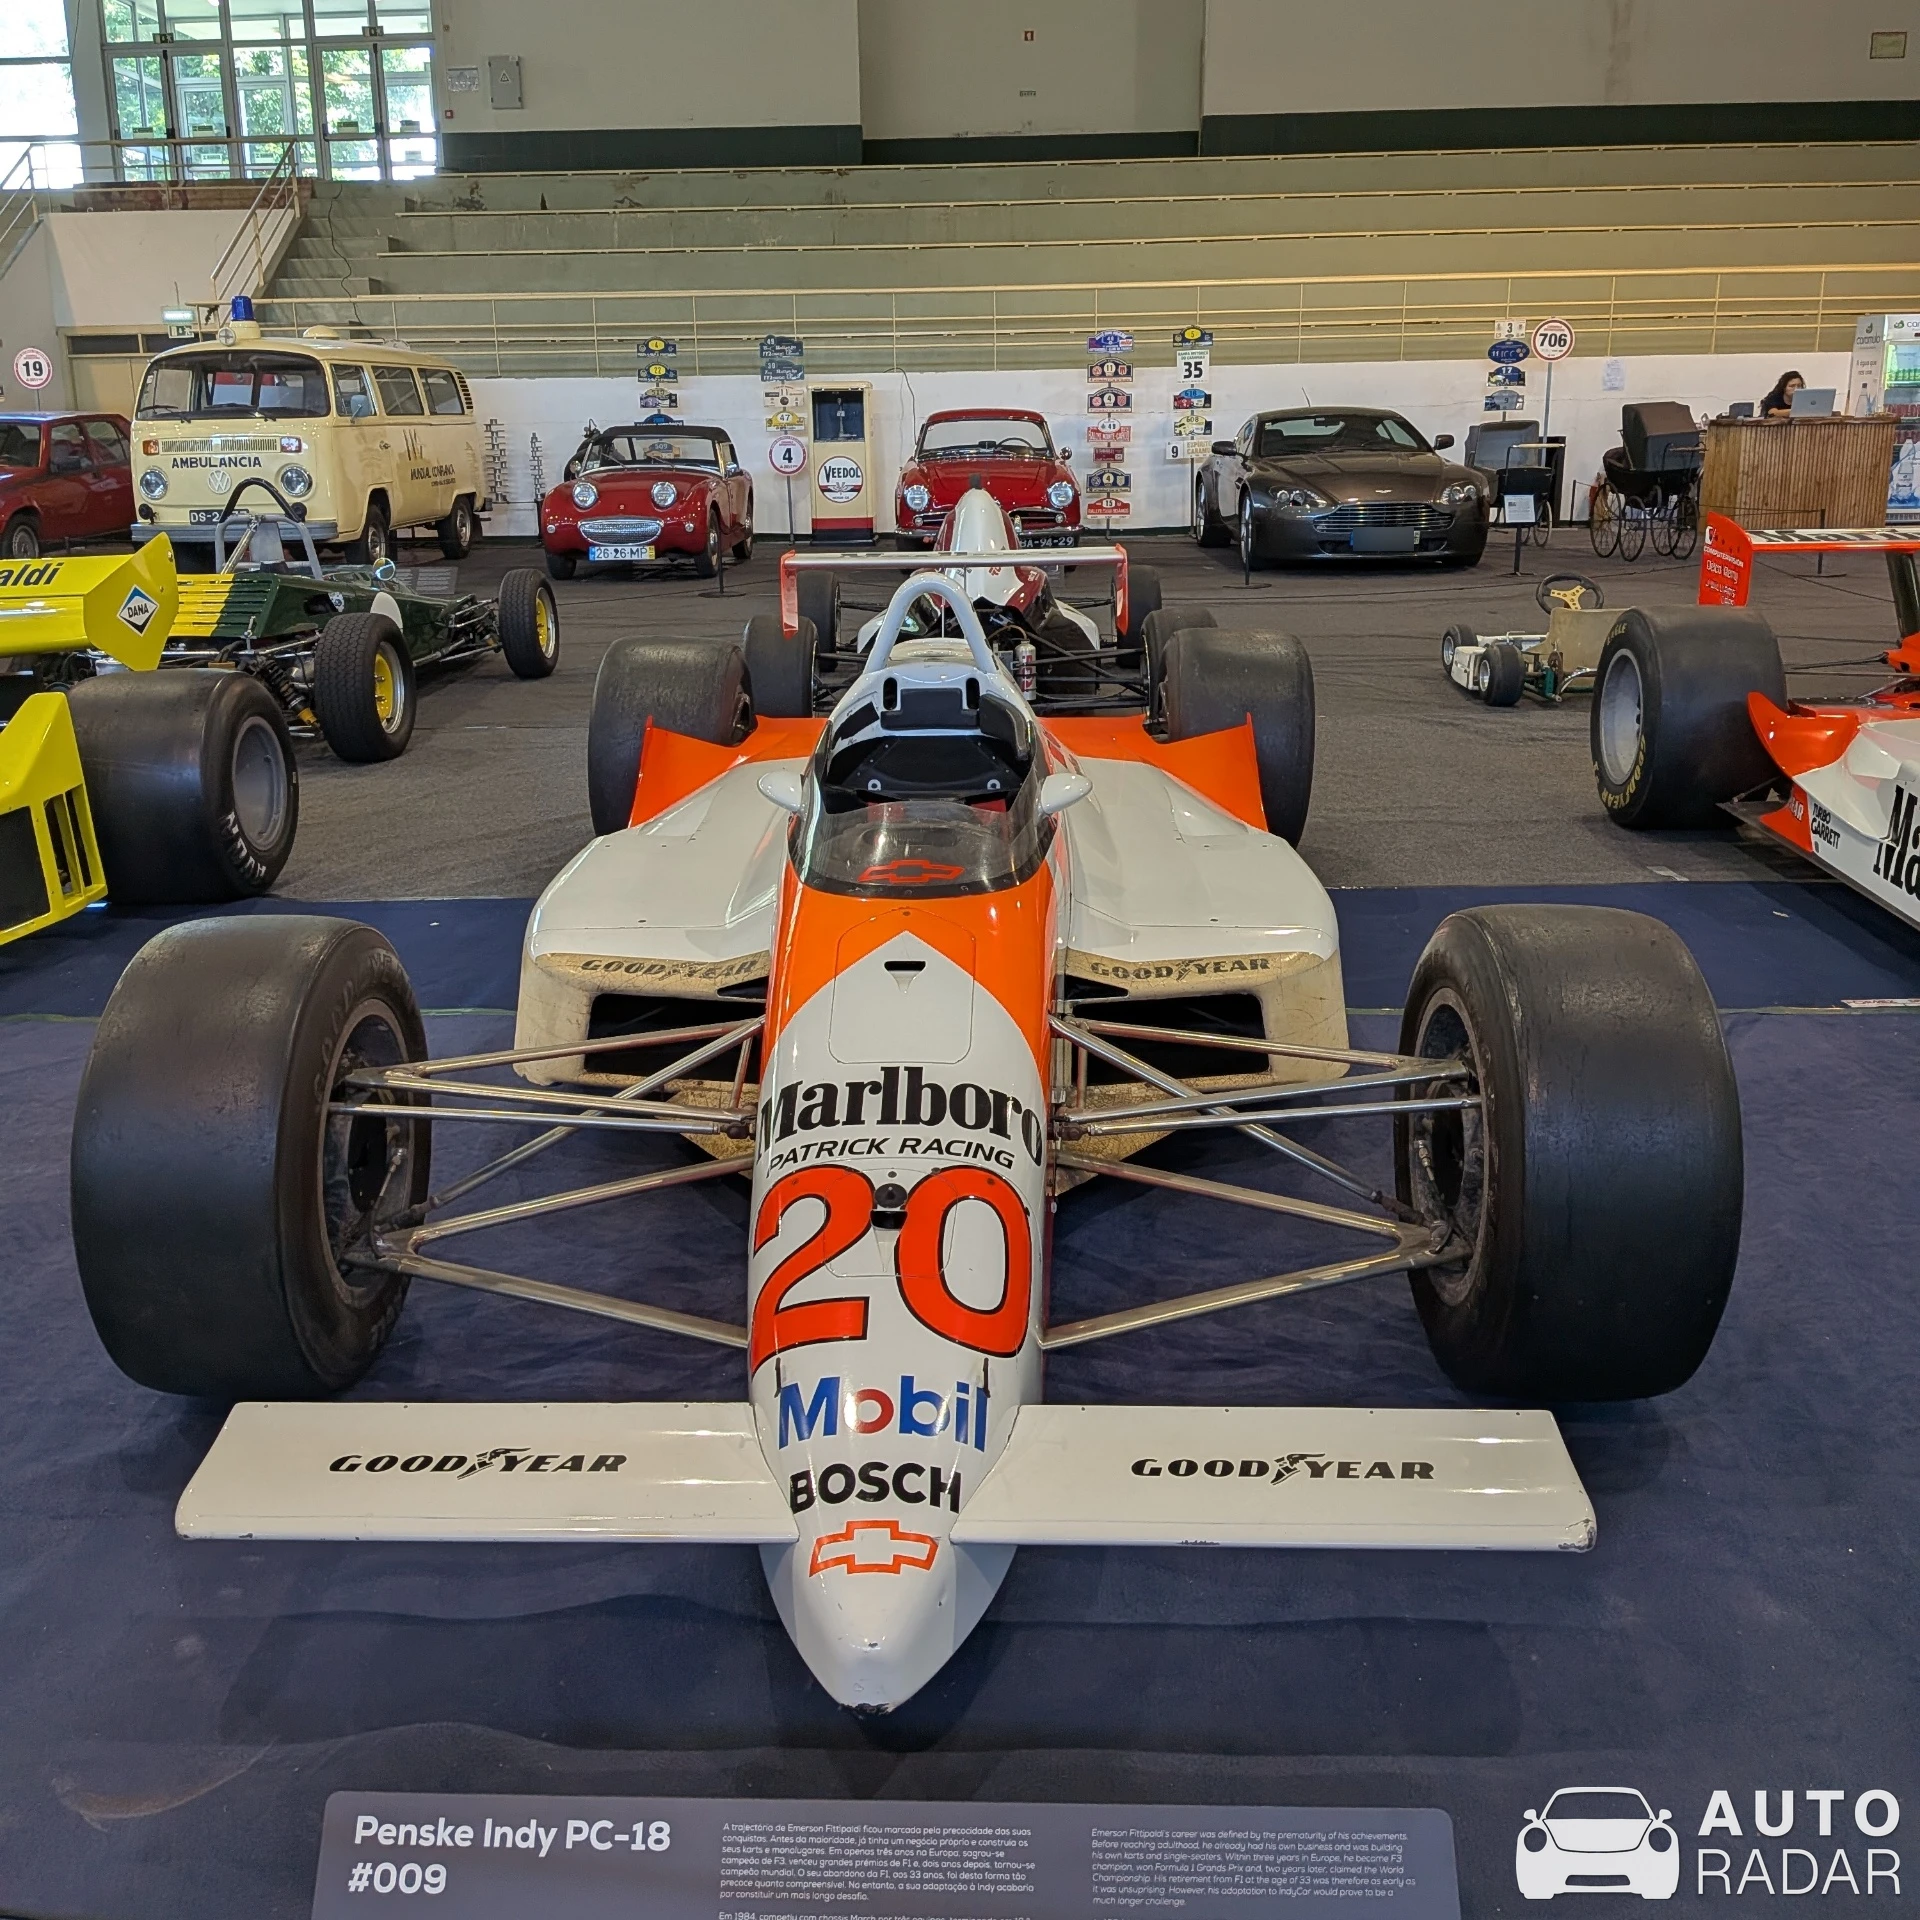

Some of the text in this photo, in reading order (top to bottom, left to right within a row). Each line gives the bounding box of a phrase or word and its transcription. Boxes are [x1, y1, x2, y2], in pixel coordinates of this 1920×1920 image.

[1507, 322, 1513, 333] 3
[1539, 333, 1568, 348] 706
[22, 360, 44, 377] 19
[1183, 361, 1203, 379] 35
[1107, 394, 1112, 402] 4
[782, 448, 793, 463] 4
[1172, 446, 1178, 458] 9
[172, 456, 262, 469] AMBULANCIA
[824, 465, 861, 483] VEEDOL
[127, 602, 150, 618] DANA
[1812, 802, 1831, 824] TURBO
[1811, 817, 1840, 849] GARRETT
[757, 1066, 1043, 1168] Marlboro
[766, 1138, 1015, 1177] PATRICK RACING
[751, 1164, 1032, 1381] 20
[778, 1375, 988, 1453] Mobil
[790, 1461, 962, 1515] BOSCH
[354, 1815, 671, 1858] Penske Indy PC-18
[732, 1823, 774, 1834] trajectória
[775, 1824, 786, 1832] de
[788, 1824, 824, 1833] Emerson
[826, 1824, 861, 1836] Fittipaldi
[863, 1825, 883, 1834] ficou
[884, 1826, 922, 1834] marcada
[923, 1826, 941, 1837] pela
[943, 1827, 994, 1838] precocidade
[995, 1827, 1010, 1836] das
[770, 1834, 794, 1843] Antes
[796, 1835, 807, 1844] da
[868, 1836, 889, 1845] tinha
[906, 1837, 938, 1848] negócio
[743, 1845, 763, 1854] karts
[829, 1846, 842, 1855] Em
[844, 1849, 875, 1858] apenas
[963, 1851, 1005, 1860] sagrou-se
[762, 1856, 773, 1865] de
[820, 1857, 853, 1869] grandes
[890, 1858, 901, 1867] de
[922, 1859, 940, 1868] dois
[994, 1860, 1036, 1869] tornou-se
[348, 1862, 448, 1894] #009
